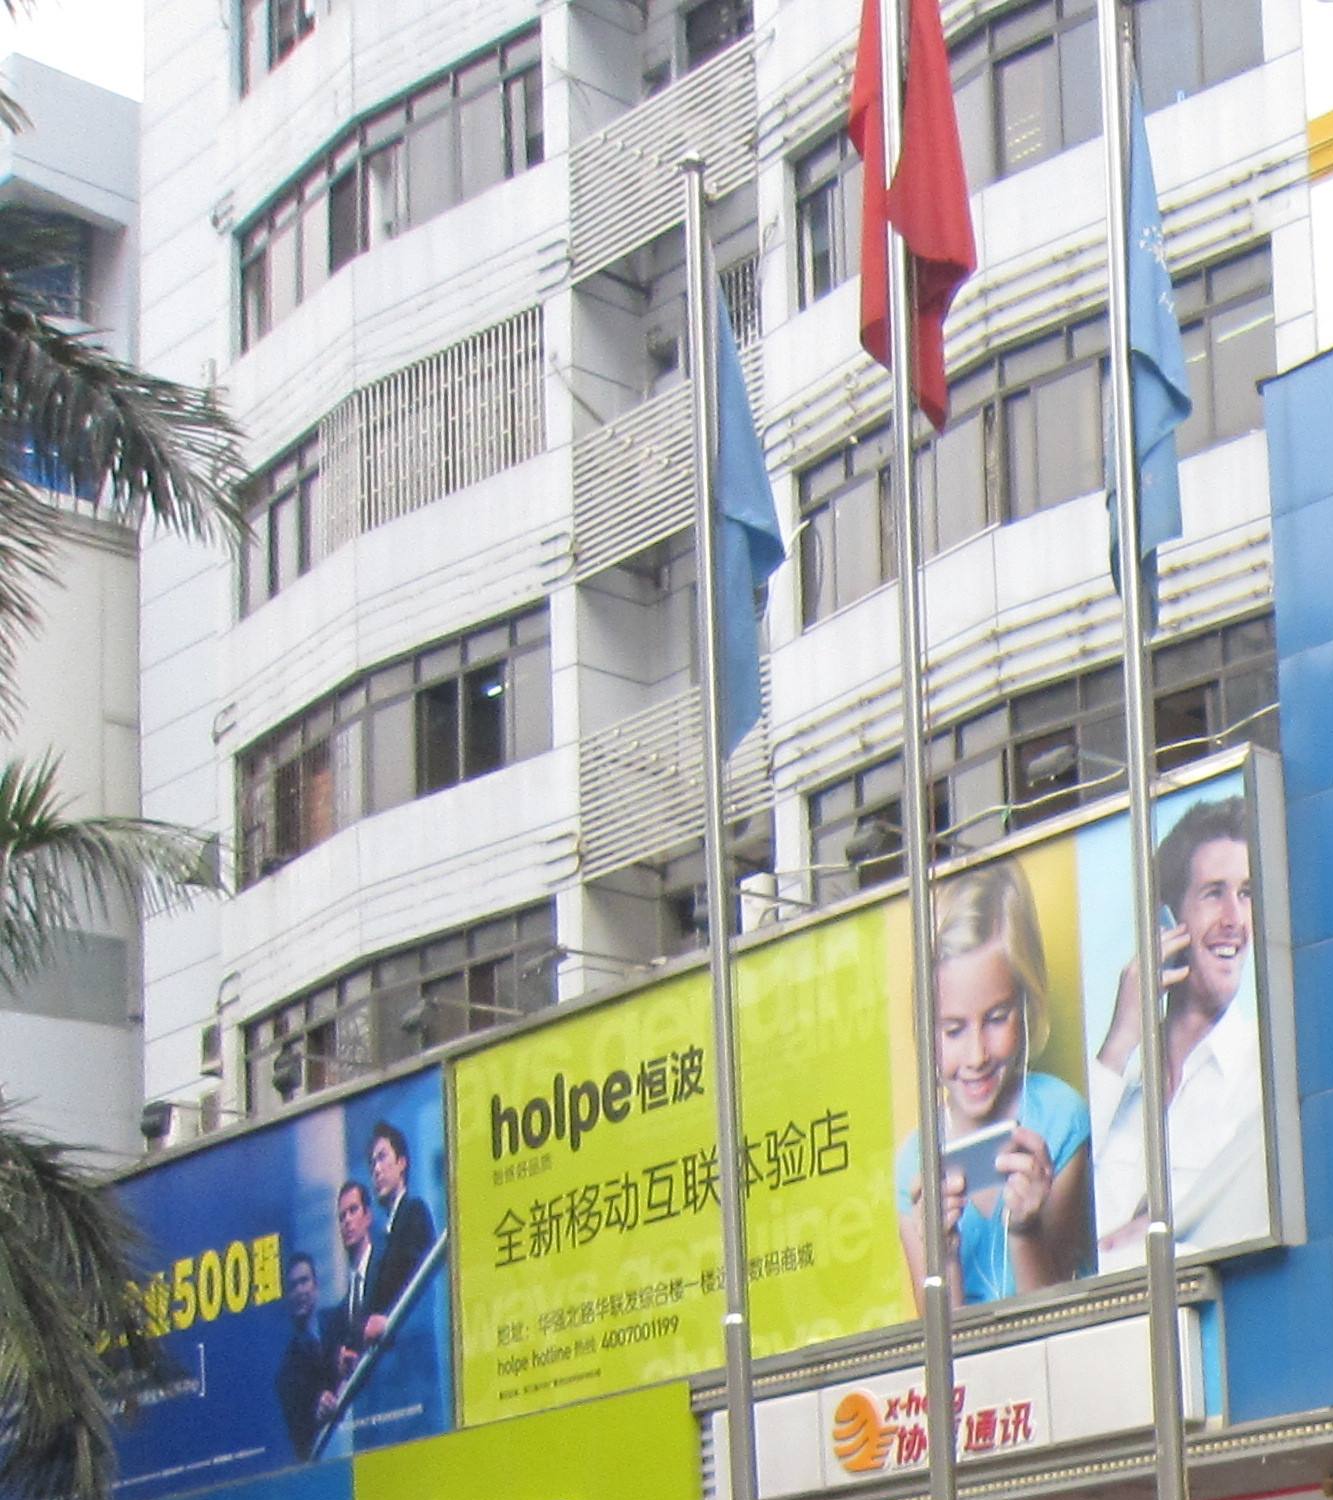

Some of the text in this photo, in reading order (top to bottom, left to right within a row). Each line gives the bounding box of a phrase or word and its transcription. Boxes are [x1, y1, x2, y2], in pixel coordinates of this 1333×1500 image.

[497, 1354, 529, 1376] holpe
[600, 1315, 680, 1351] 4007001199
[896, 1401, 1033, 1466] 协通讯
